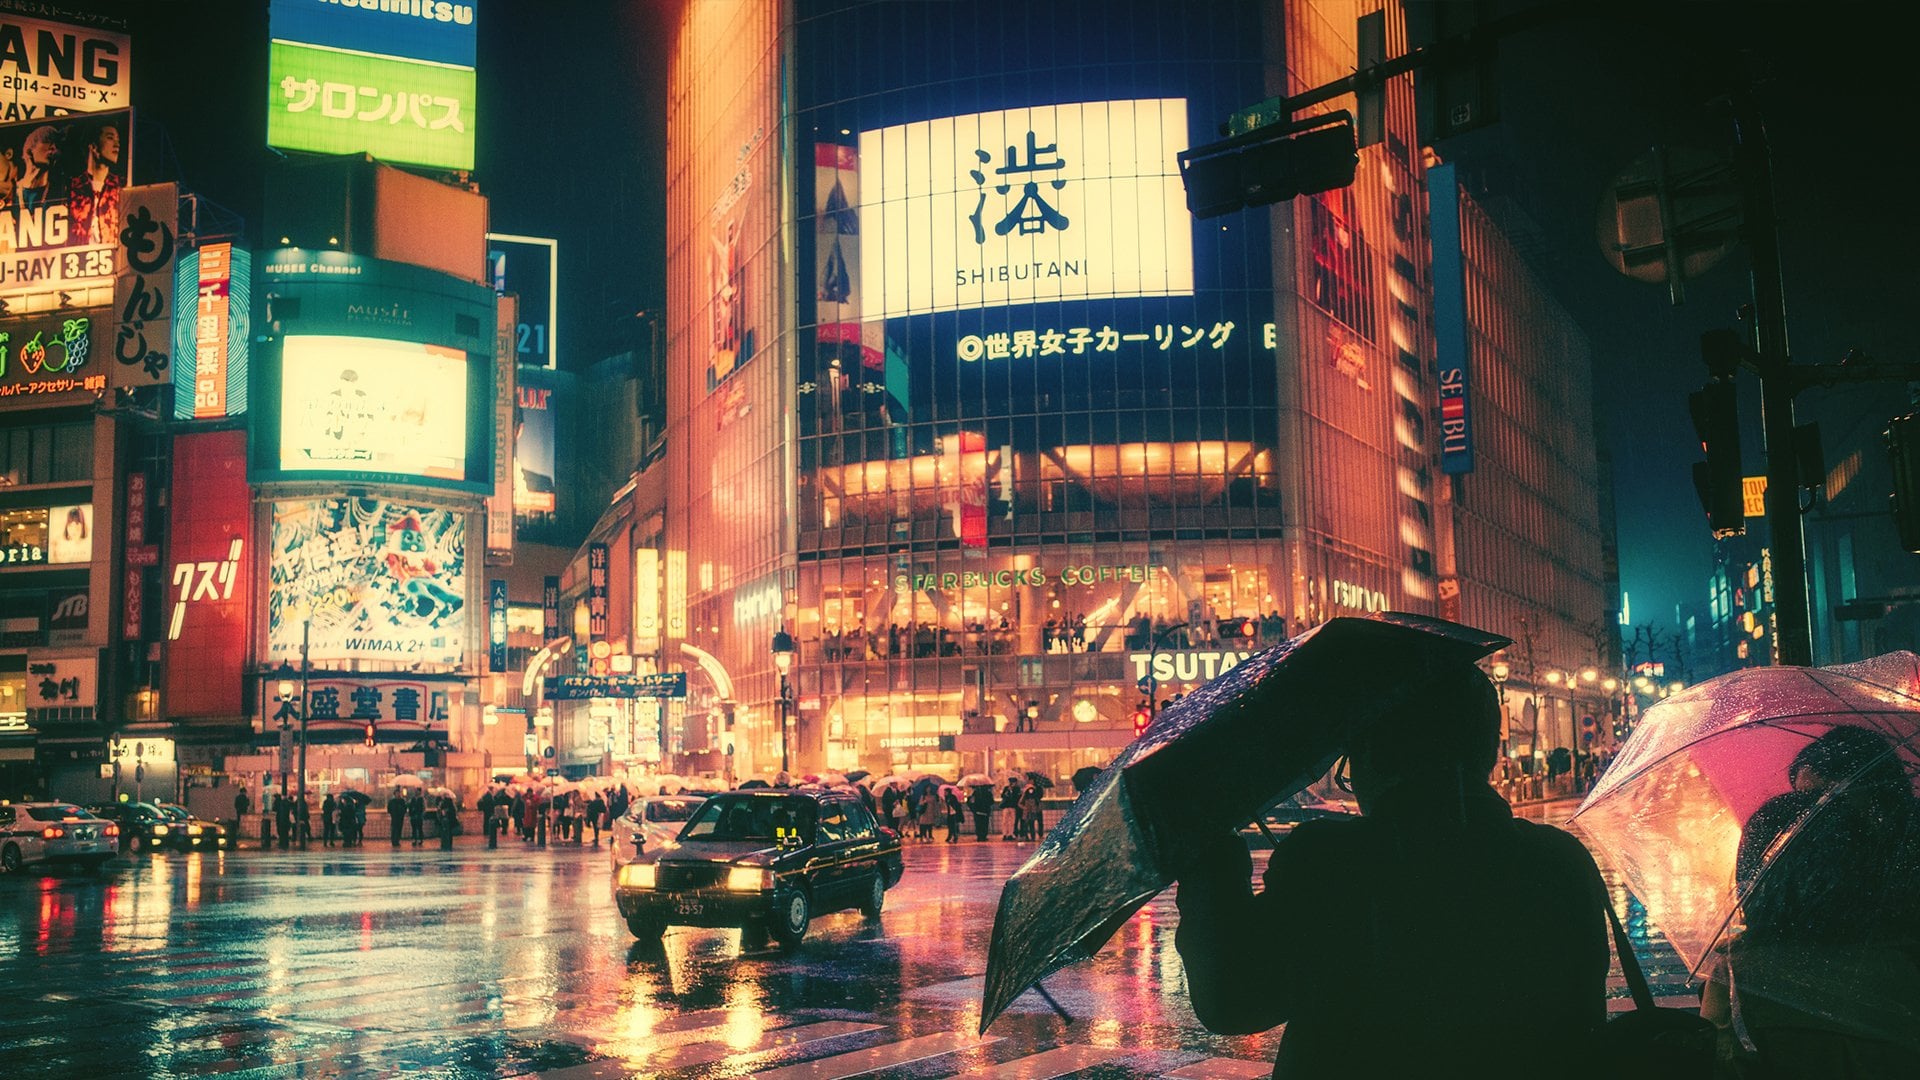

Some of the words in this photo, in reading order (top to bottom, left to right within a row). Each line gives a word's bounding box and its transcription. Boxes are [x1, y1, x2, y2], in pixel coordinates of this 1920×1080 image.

[0, 102, 37, 121] AY
[280, 75, 465, 133] サロンパス
[969, 130, 1070, 244] 渋
[64, 249, 114, 278] 3.25
[265, 263, 307, 273] MUSEE
[310, 264, 362, 275] Channel
[955, 259, 1090, 287] SHIBUTANI
[114, 206, 178, 381] もんじゃ
[194, 250, 224, 409] 三千里薬品
[517, 323, 546, 355] 21
[0, 375, 106, 396] ルバーアクセサリー雑貨
[1439, 368, 1467, 455] SEIBU
[894, 568, 1047, 594] STARBUCKS
[1060, 563, 1160, 587] COFFEE
[51, 594, 88, 622] JTB
[345, 638, 403, 653] WiMAX
[407, 639, 426, 653] 2+
[879, 736, 940, 749] STARBUCKS
